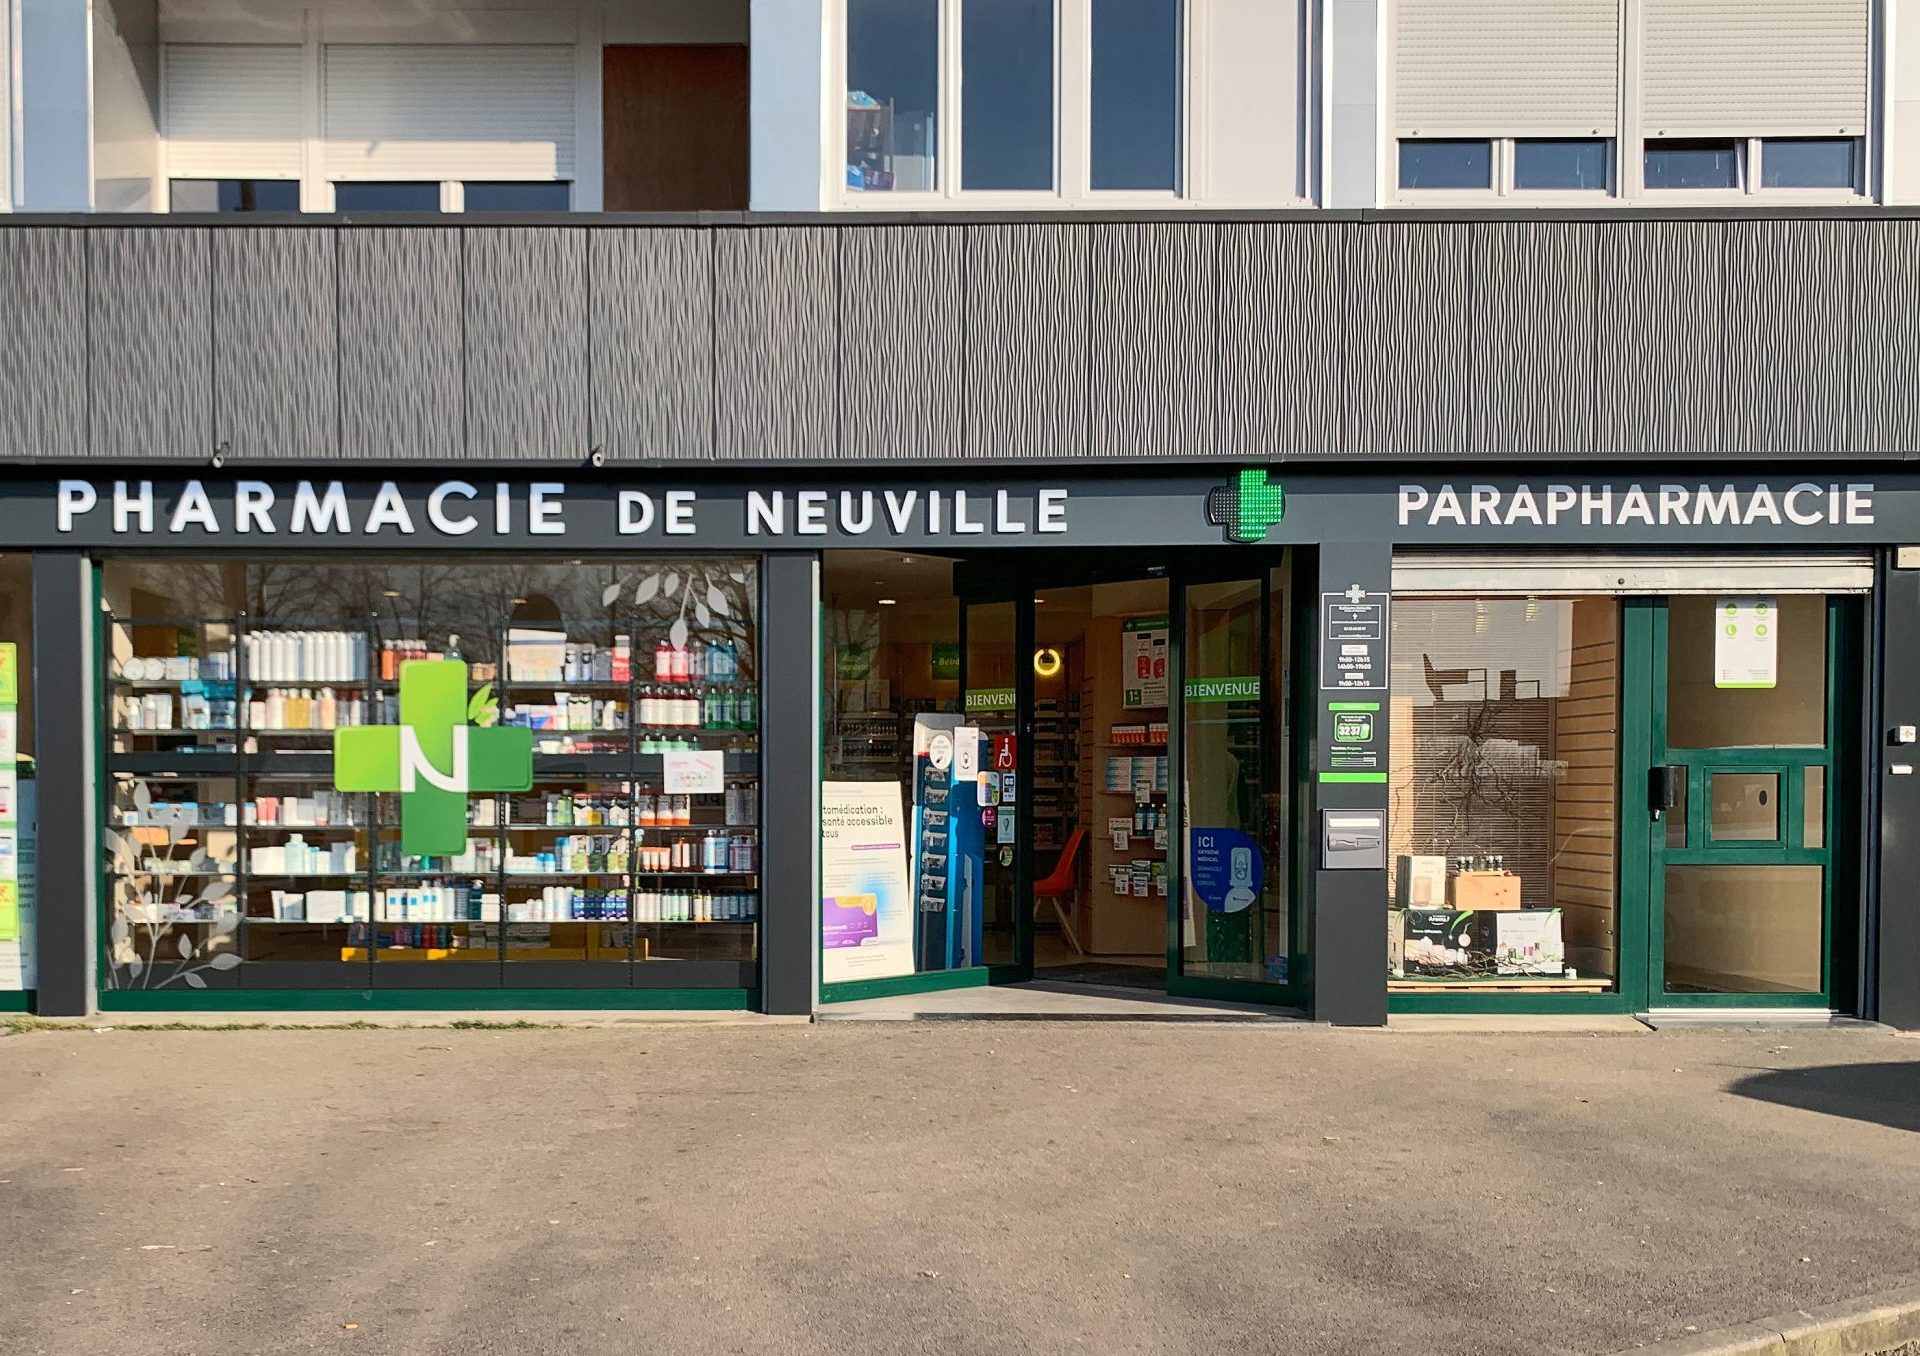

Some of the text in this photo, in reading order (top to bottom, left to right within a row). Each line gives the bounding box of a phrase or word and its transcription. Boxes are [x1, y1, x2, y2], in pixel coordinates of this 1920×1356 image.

[56, 479, 1069, 536] PHARMACIE DE NEUVILLE
[1397, 482, 1876, 527] PARAPHARMACIE
[1185, 682, 1260, 697] BIENVENUE
[966, 693, 1016, 706] BIENVEN
[823, 803, 878, 815] tomédication
[822, 815, 893, 827] santé accessible
[1198, 836, 1214, 848] ICI
